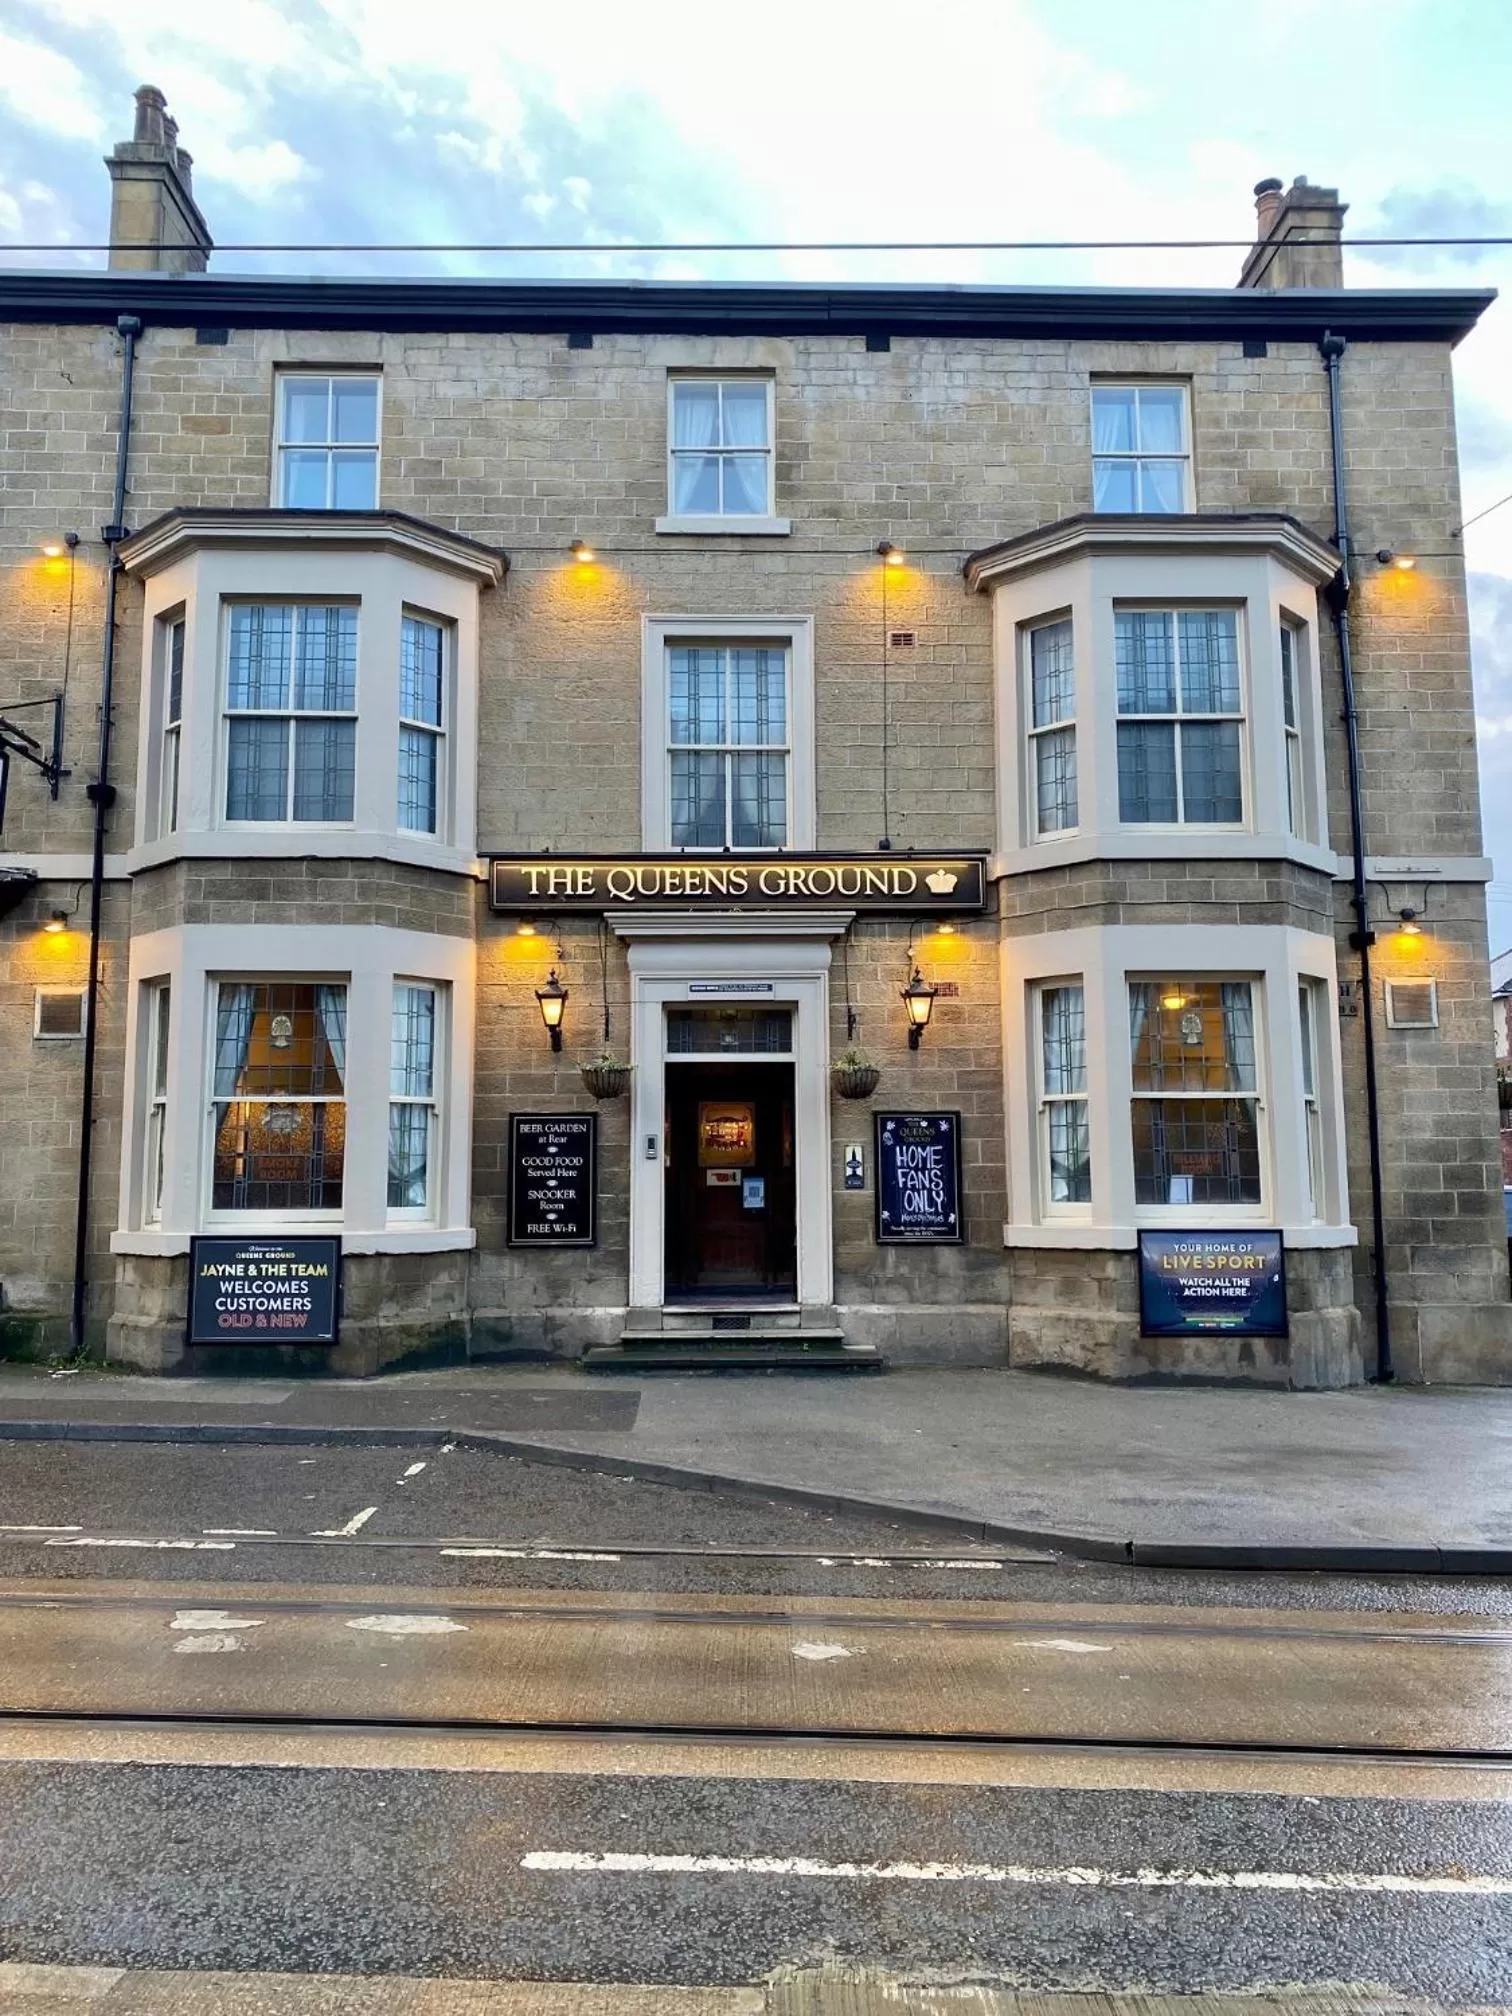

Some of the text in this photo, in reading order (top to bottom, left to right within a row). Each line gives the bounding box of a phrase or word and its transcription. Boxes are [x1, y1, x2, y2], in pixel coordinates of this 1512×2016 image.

[521, 866, 917, 901] THE QUEENS GROUND
[519, 1123, 587, 1133] BEER GARDEN
[900, 1127, 936, 1137] QUEENS
[538, 1134, 567, 1144] at Rear
[522, 1157, 583, 1166] GOOD FOOD
[895, 1145, 943, 1169] HOME
[527, 1168, 578, 1177] Served Here
[897, 1168, 944, 1191] FANS
[527, 1190, 577, 1200] SNOOKER
[540, 1201, 565, 1210] Room
[904, 1189, 944, 1213] ONLY
[527, 1224, 577, 1234] FREE Wi-Fi
[1174, 1244, 1253, 1252] YOUR HOME OF
[265, 1251, 296, 1259] GROUND
[1163, 1255, 1266, 1269] LIVE SPORT
[200, 1264, 328, 1277] JAYNE & THE TEAM
[219, 1280, 309, 1294] WELCOMES
[1178, 1277, 1250, 1287] WATCH ALL THE
[1183, 1287, 1248, 1297] ACTION HERE
[215, 1297, 312, 1311] CUSTOMERS
[217, 1313, 308, 1328] OLD & NEW
